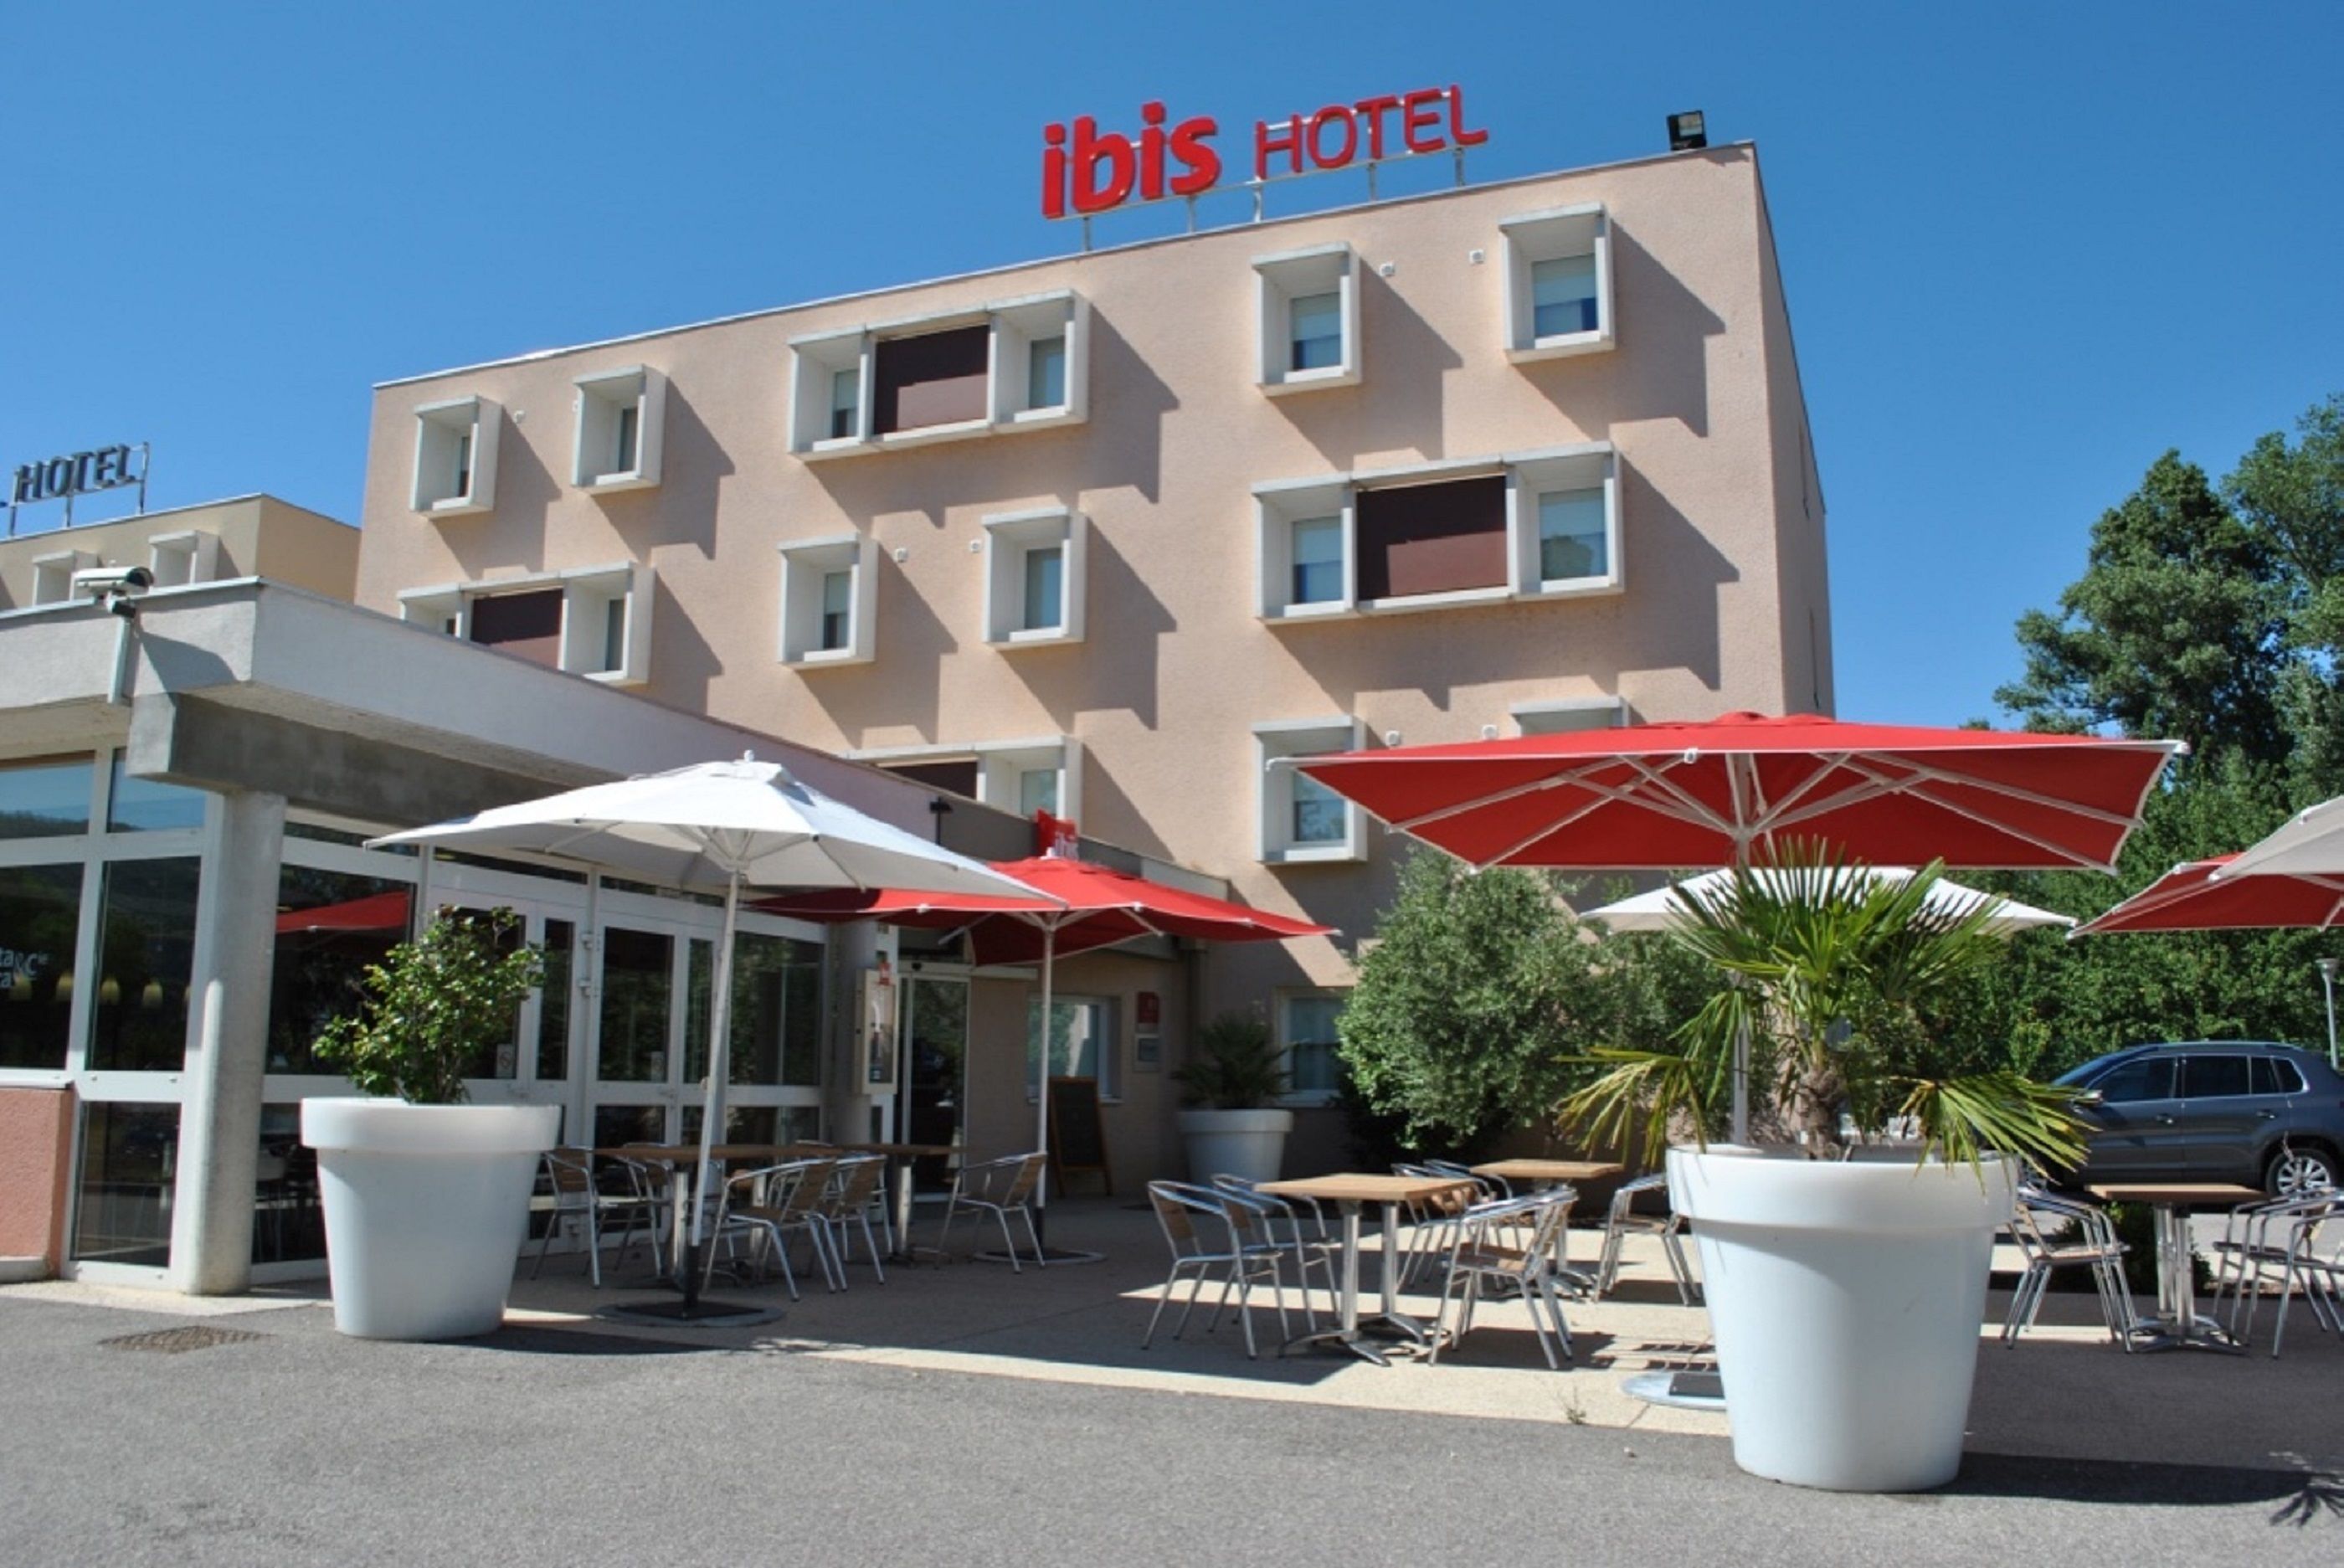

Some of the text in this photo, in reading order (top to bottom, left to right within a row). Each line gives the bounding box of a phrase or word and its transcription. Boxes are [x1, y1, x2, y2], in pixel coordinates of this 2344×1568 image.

[1042, 85, 1488, 219] ibis HOTEL
[16, 443, 136, 502] HOTEL
